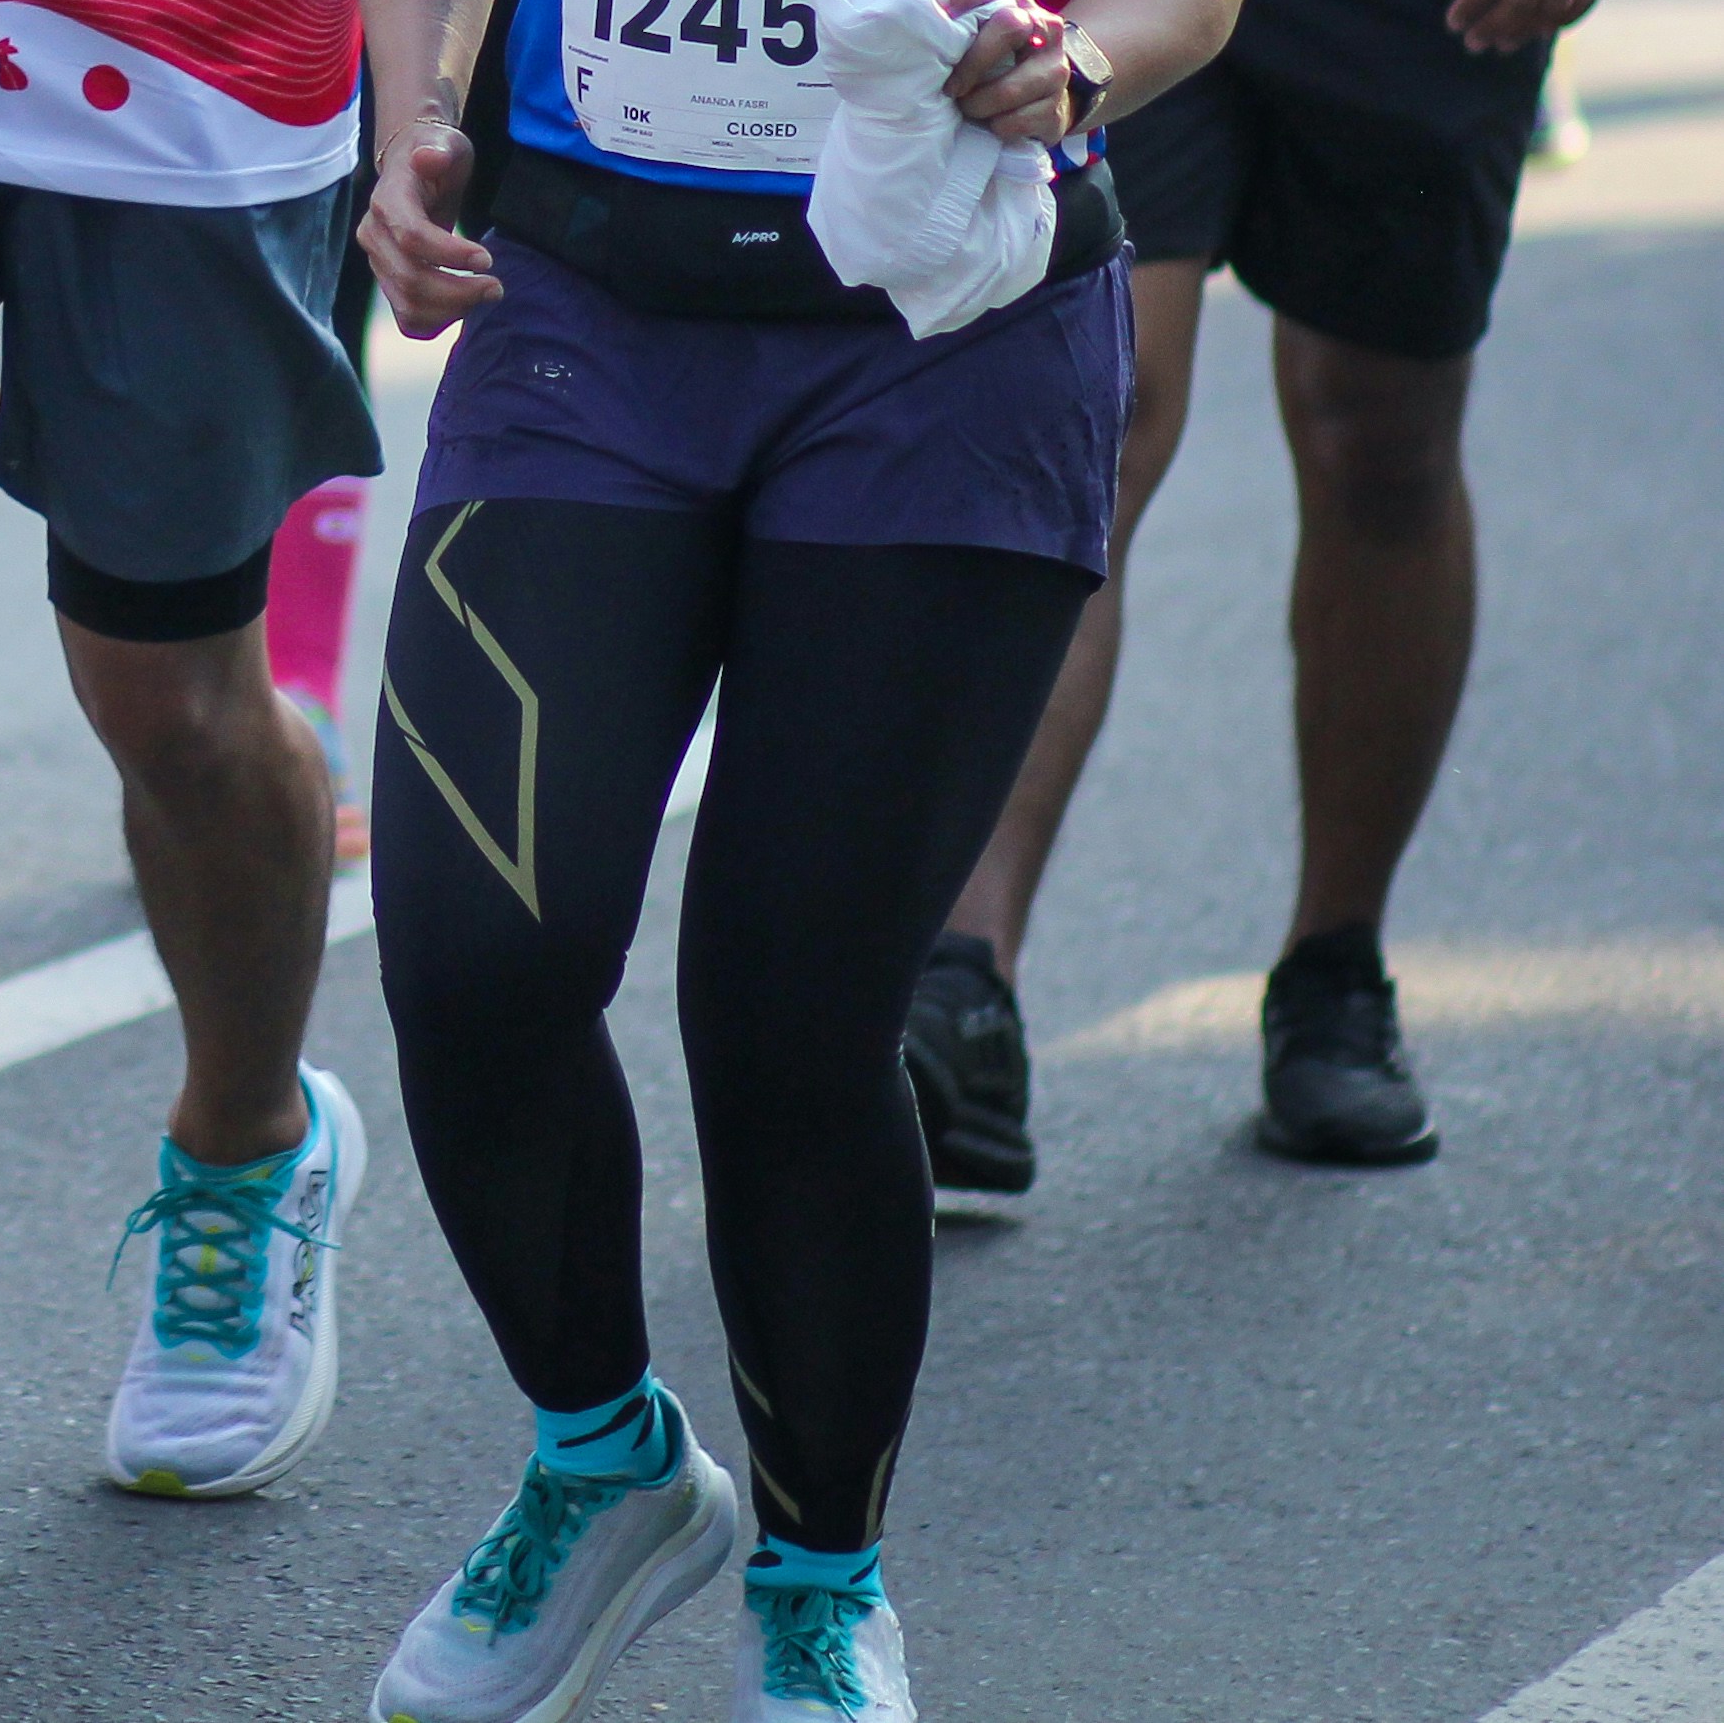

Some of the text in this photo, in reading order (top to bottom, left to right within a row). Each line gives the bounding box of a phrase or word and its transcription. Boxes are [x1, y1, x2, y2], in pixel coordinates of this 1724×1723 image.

[577, 66, 593, 104] F
[690, 94, 769, 109] ANANDA FASRI
[622, 105, 798, 137] 10K CLOSED
